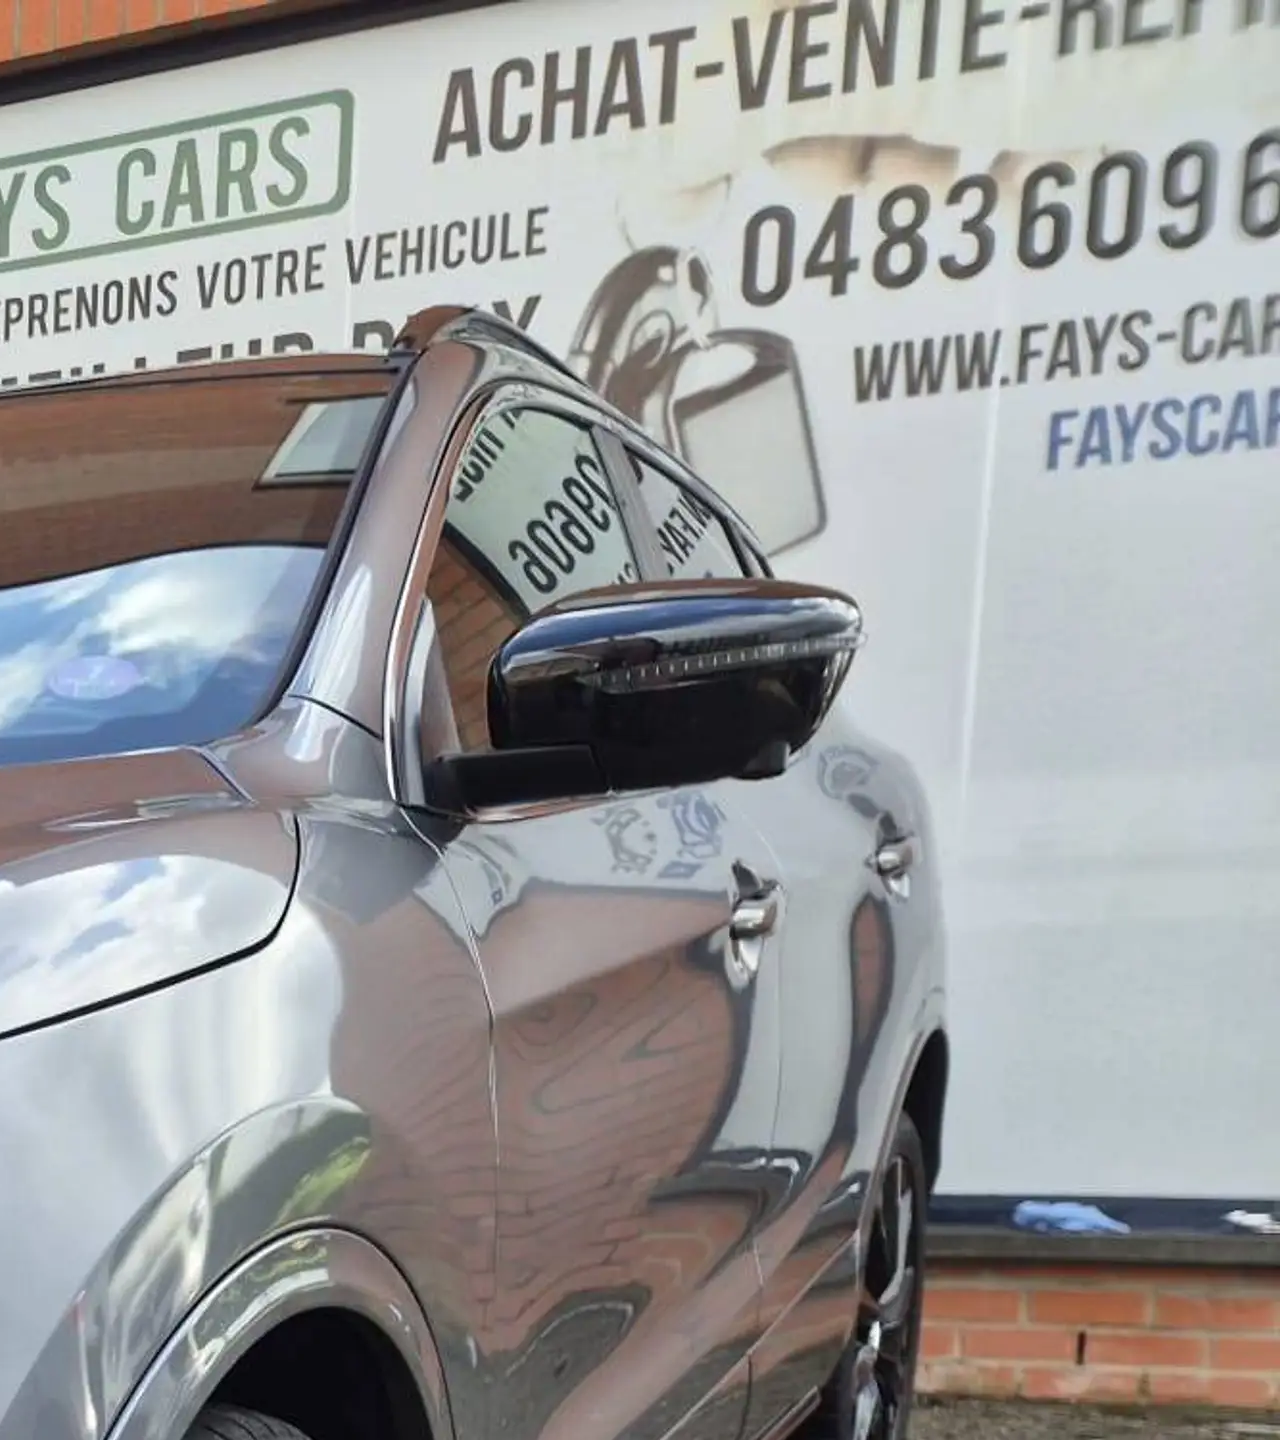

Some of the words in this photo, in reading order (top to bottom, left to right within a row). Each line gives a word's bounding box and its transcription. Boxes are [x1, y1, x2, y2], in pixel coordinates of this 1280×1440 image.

[115, 116, 311, 237] CARS
[741, 126, 1280, 307] 04836096
[197, 244, 327, 309] VOTRE
[345, 206, 549, 284] VEHICULE
